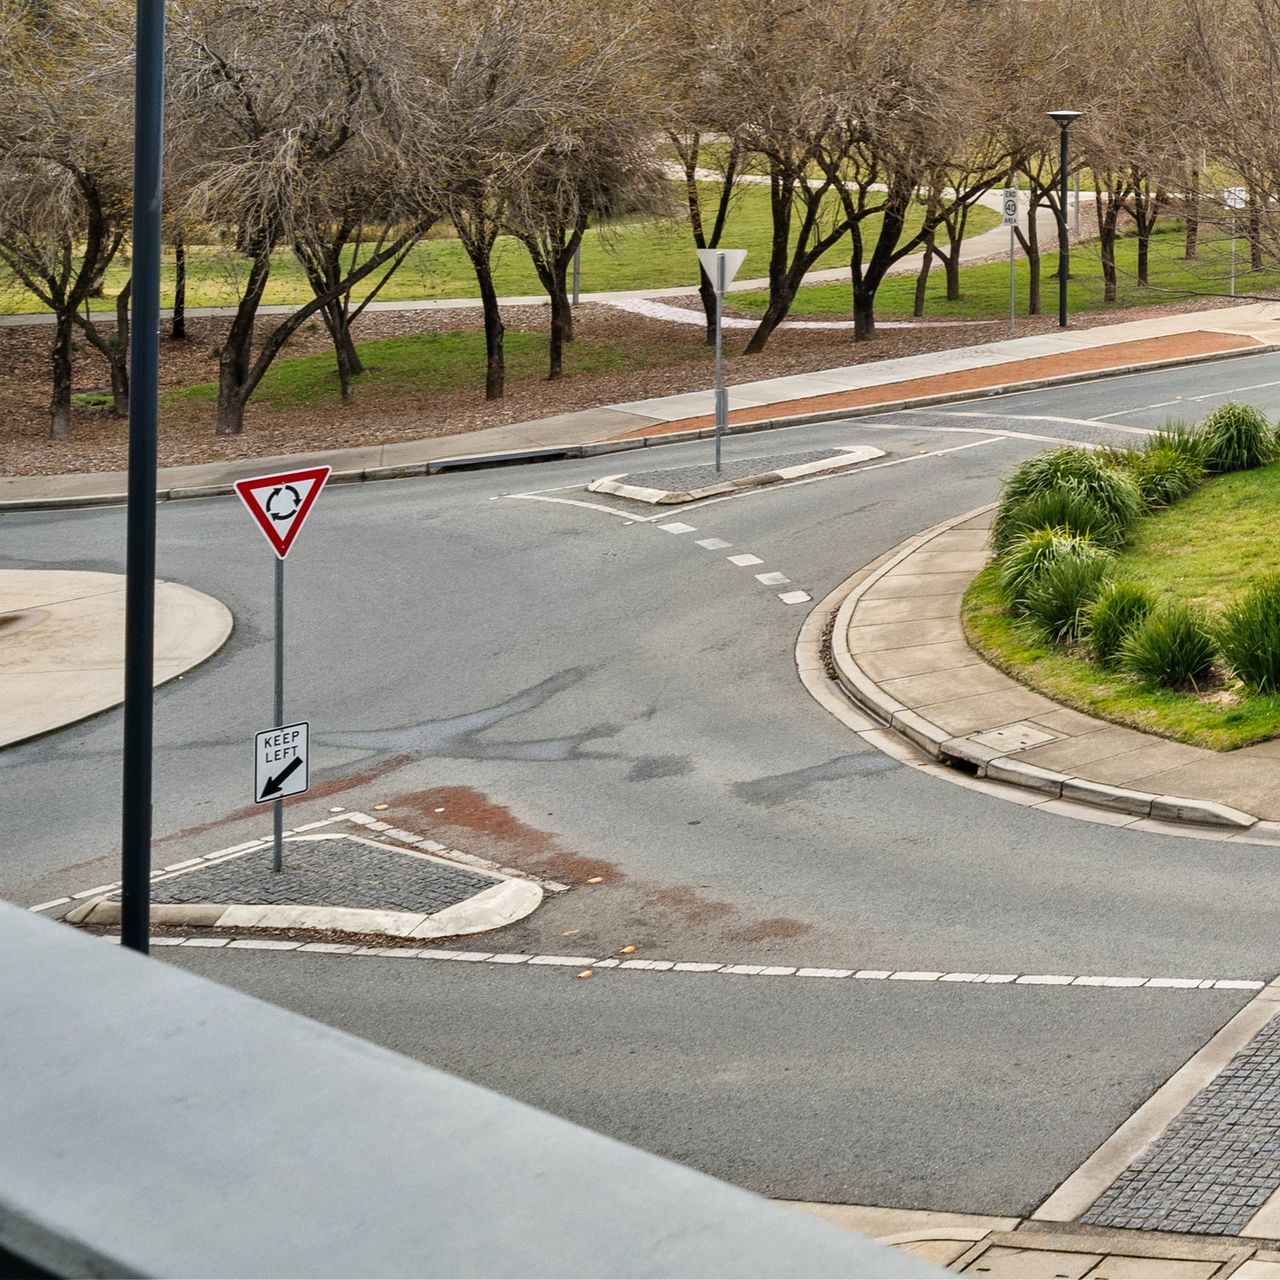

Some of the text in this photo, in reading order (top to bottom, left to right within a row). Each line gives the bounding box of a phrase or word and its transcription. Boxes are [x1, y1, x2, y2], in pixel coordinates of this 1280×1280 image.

[1005, 190, 1016, 198] END
[264, 730, 300, 748] KEEP
[265, 745, 298, 763] LEFT
